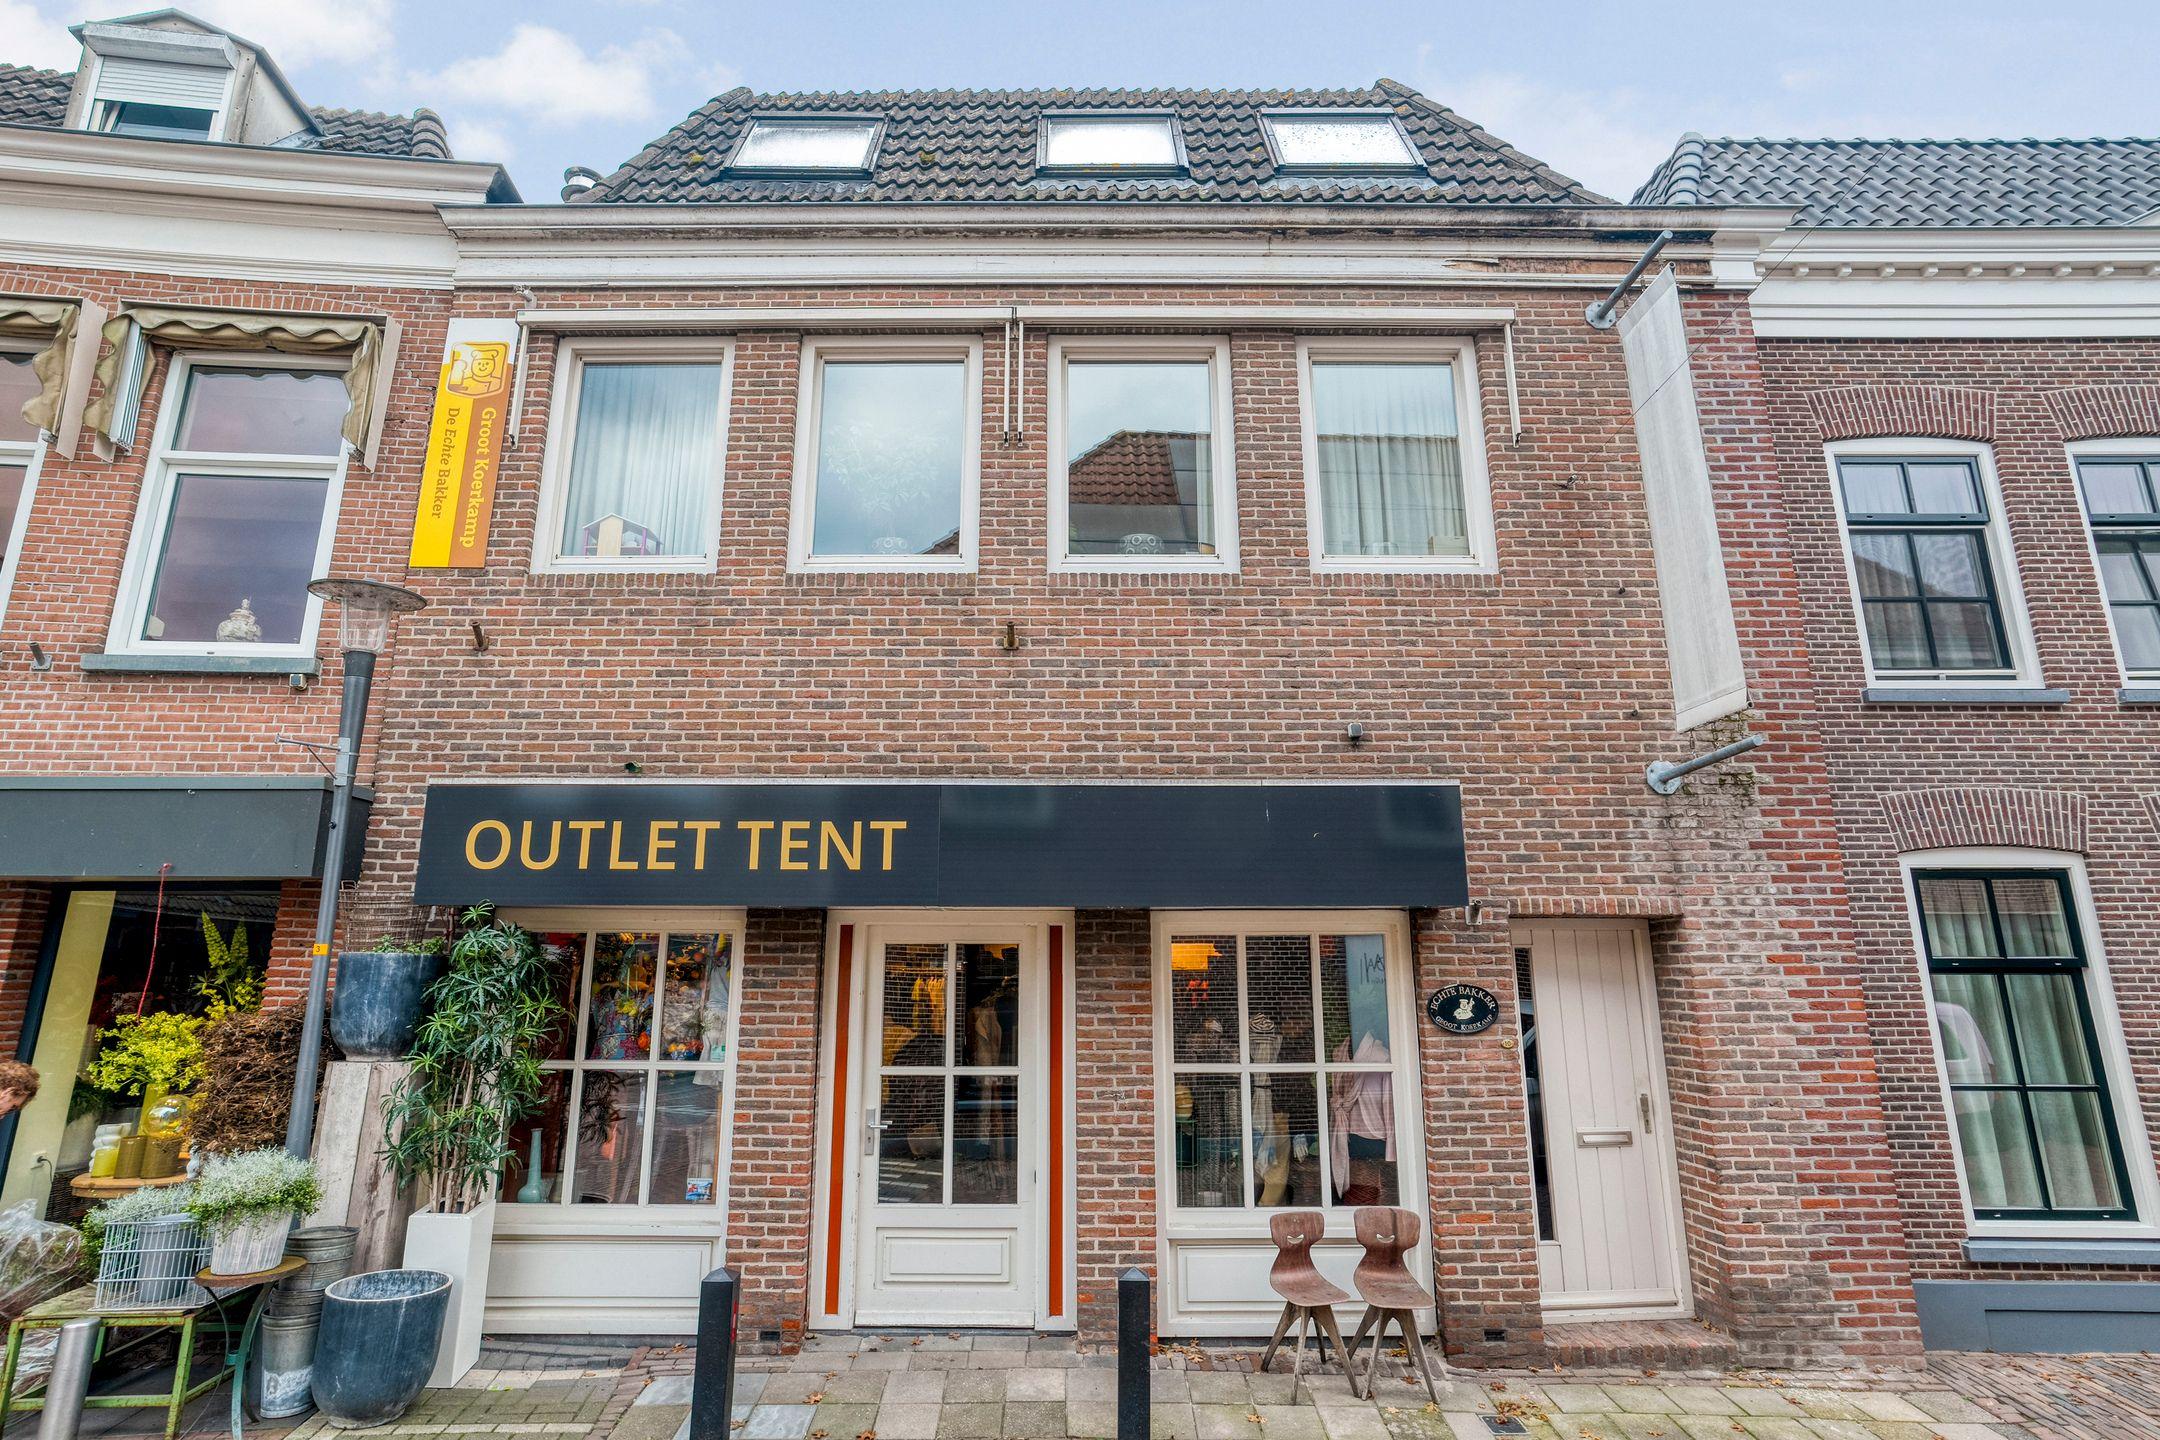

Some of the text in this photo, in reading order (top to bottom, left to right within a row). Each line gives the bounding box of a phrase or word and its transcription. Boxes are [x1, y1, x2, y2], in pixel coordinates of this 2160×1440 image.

[431, 407, 461, 519] De Echte Bakker
[460, 407, 497, 548] Groot Koerkamp
[464, 819, 907, 871] OUTLET TENT
[1430, 986, 1496, 1010] ECHTE BAKKER
[1435, 1015, 1458, 1029] GROOT
